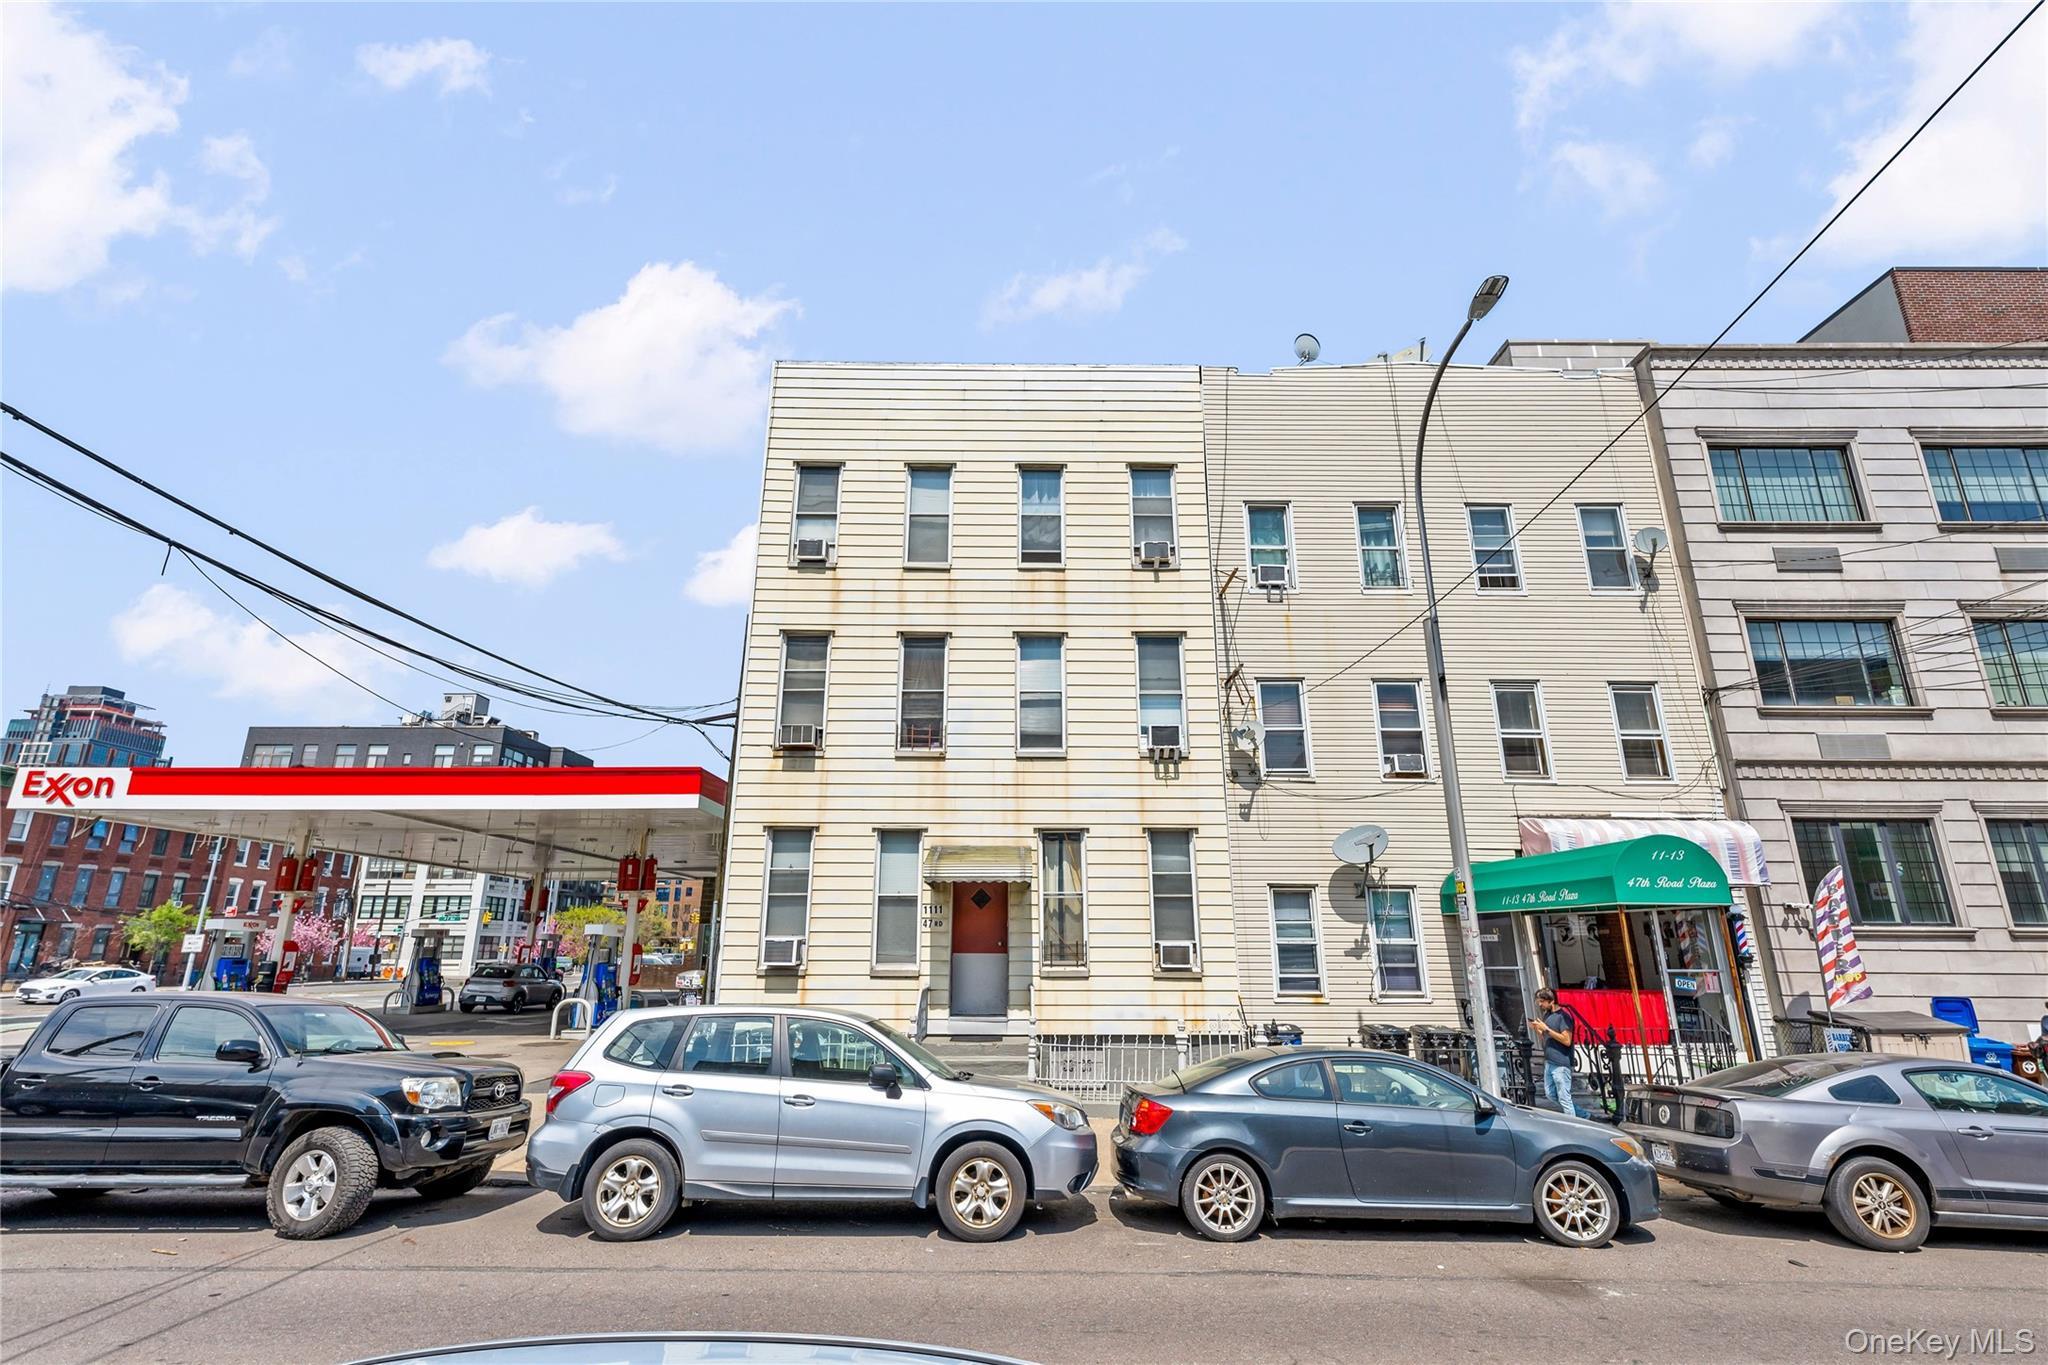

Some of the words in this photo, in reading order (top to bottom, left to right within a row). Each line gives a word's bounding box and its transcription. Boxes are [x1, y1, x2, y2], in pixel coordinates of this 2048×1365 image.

[22, 770, 115, 807] Exxon
[1651, 849, 1685, 861] 11-13
[1627, 876, 1651, 888] 47th
[1654, 875, 1684, 889] Road
[1687, 875, 1717, 889] Plaza
[1502, 893, 1520, 906] 11-13
[1522, 892, 1536, 904] 47th
[1538, 889, 1557, 903] Road
[1558, 887, 1579, 901] Plaza
[923, 905, 943, 914] 1111
[922, 919, 933, 928] 47
[934, 920, 943, 928] RD
[1834, 972, 1863, 983] HOP
[1677, 980, 1696, 989] OPEN
